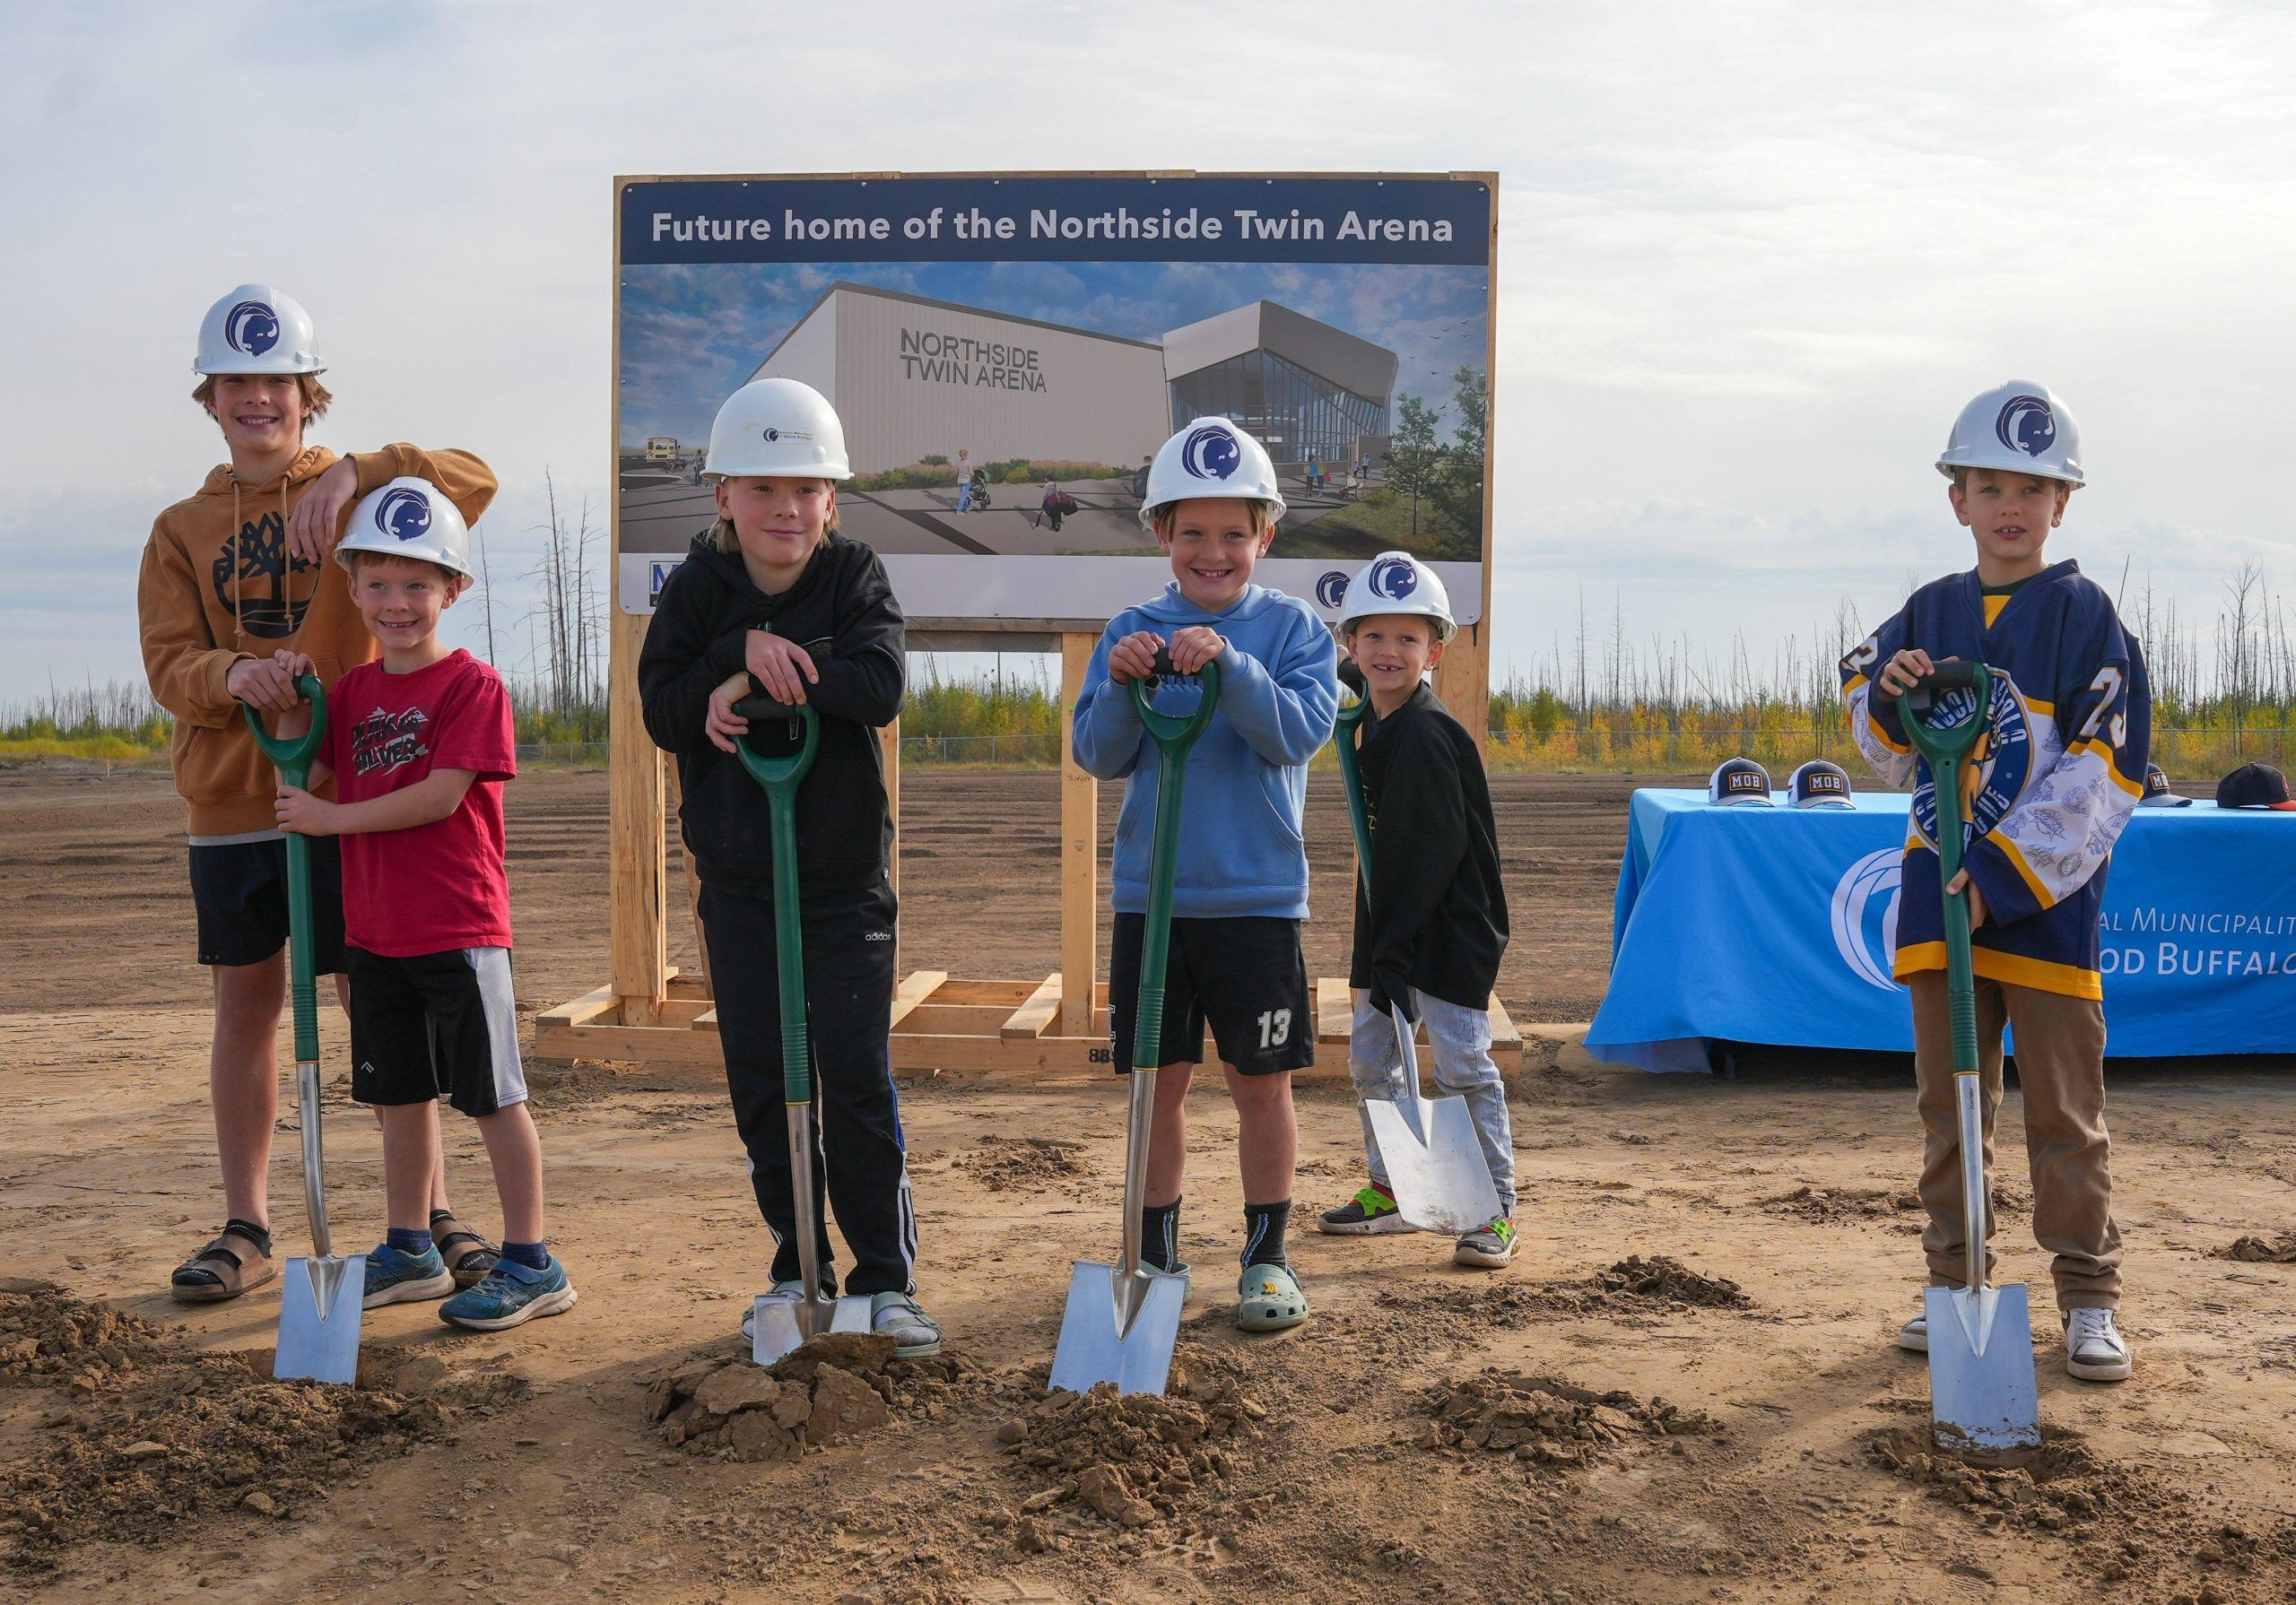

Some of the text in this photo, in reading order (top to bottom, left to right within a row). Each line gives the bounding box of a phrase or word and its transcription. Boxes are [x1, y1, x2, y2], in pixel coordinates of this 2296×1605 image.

[652, 207, 1453, 242] Future home of the Northside Twin Arena
[900, 327, 1039, 371] NORTHSIDE
[900, 355, 1048, 394] TWIN ARENA
[1732, 774, 1760, 787] MOB
[1812, 776, 1841, 789] MOB
[2153, 775, 2170, 788] MO
[2131, 907, 2296, 934] MUNICIPALIT
[865, 932, 891, 941] adidas
[2100, 948, 2145, 975] OD
[1257, 1008, 1292, 1049] 13
[1089, 1048, 1114, 1063] 88
